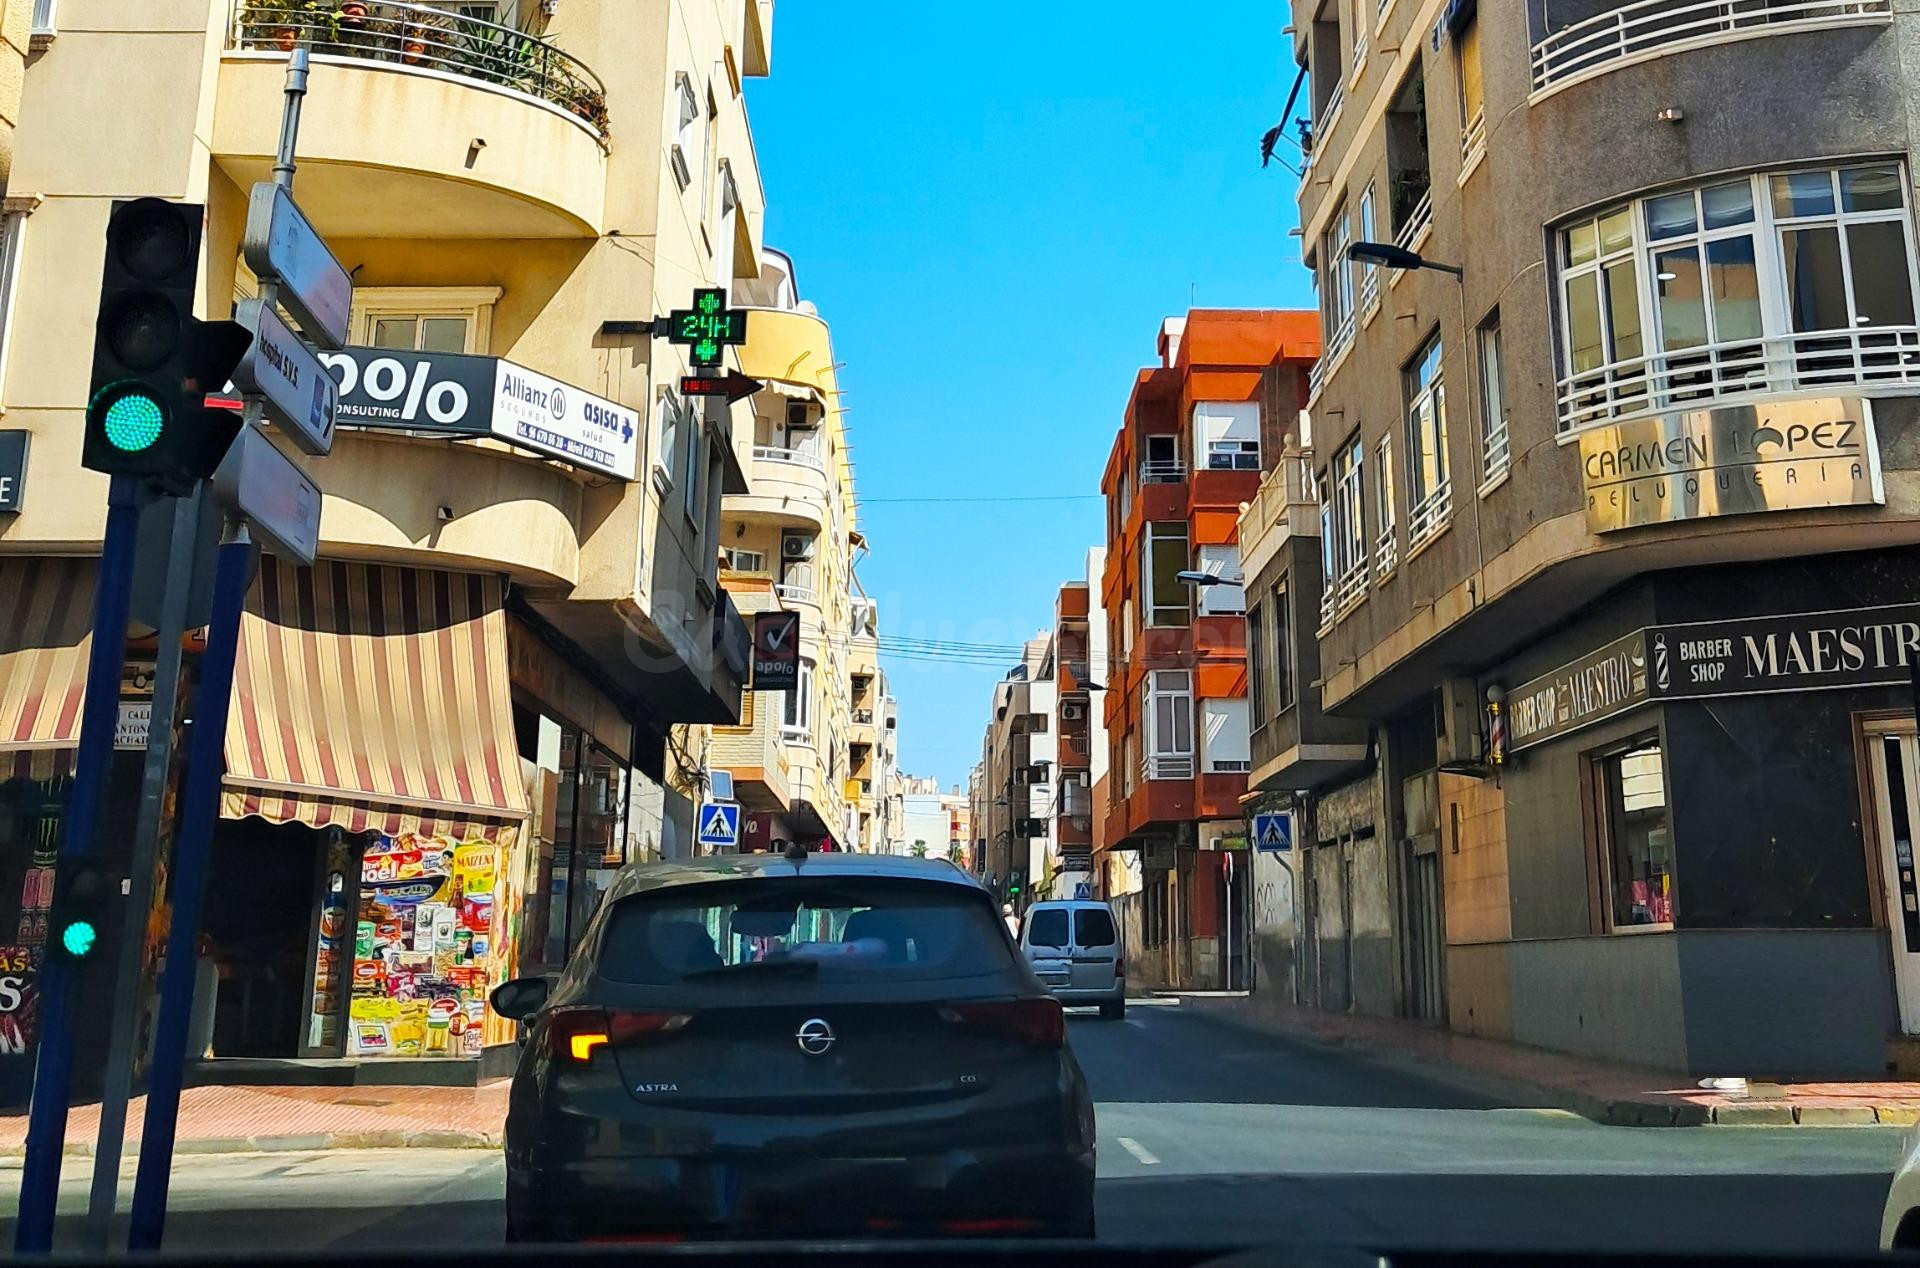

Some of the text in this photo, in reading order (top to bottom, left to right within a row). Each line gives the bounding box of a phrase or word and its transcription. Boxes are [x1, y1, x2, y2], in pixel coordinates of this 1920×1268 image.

[682, 315, 731, 338] 24H
[502, 373, 547, 409] Allianz
[337, 404, 400, 418] ONSULTING
[500, 400, 547, 424] SEGUROS
[583, 401, 619, 432] asisa
[582, 429, 603, 444] salud
[1585, 418, 1860, 480] CARMEN LÓPEZ
[1680, 638, 1733, 661] BARBER
[756, 661, 795, 675] apolo
[1690, 662, 1726, 684] SHOP
[1536, 686, 1556, 733] SHOP
[1568, 651, 1630, 720] MAESTRO
[635, 1083, 679, 1092] ASTRA
